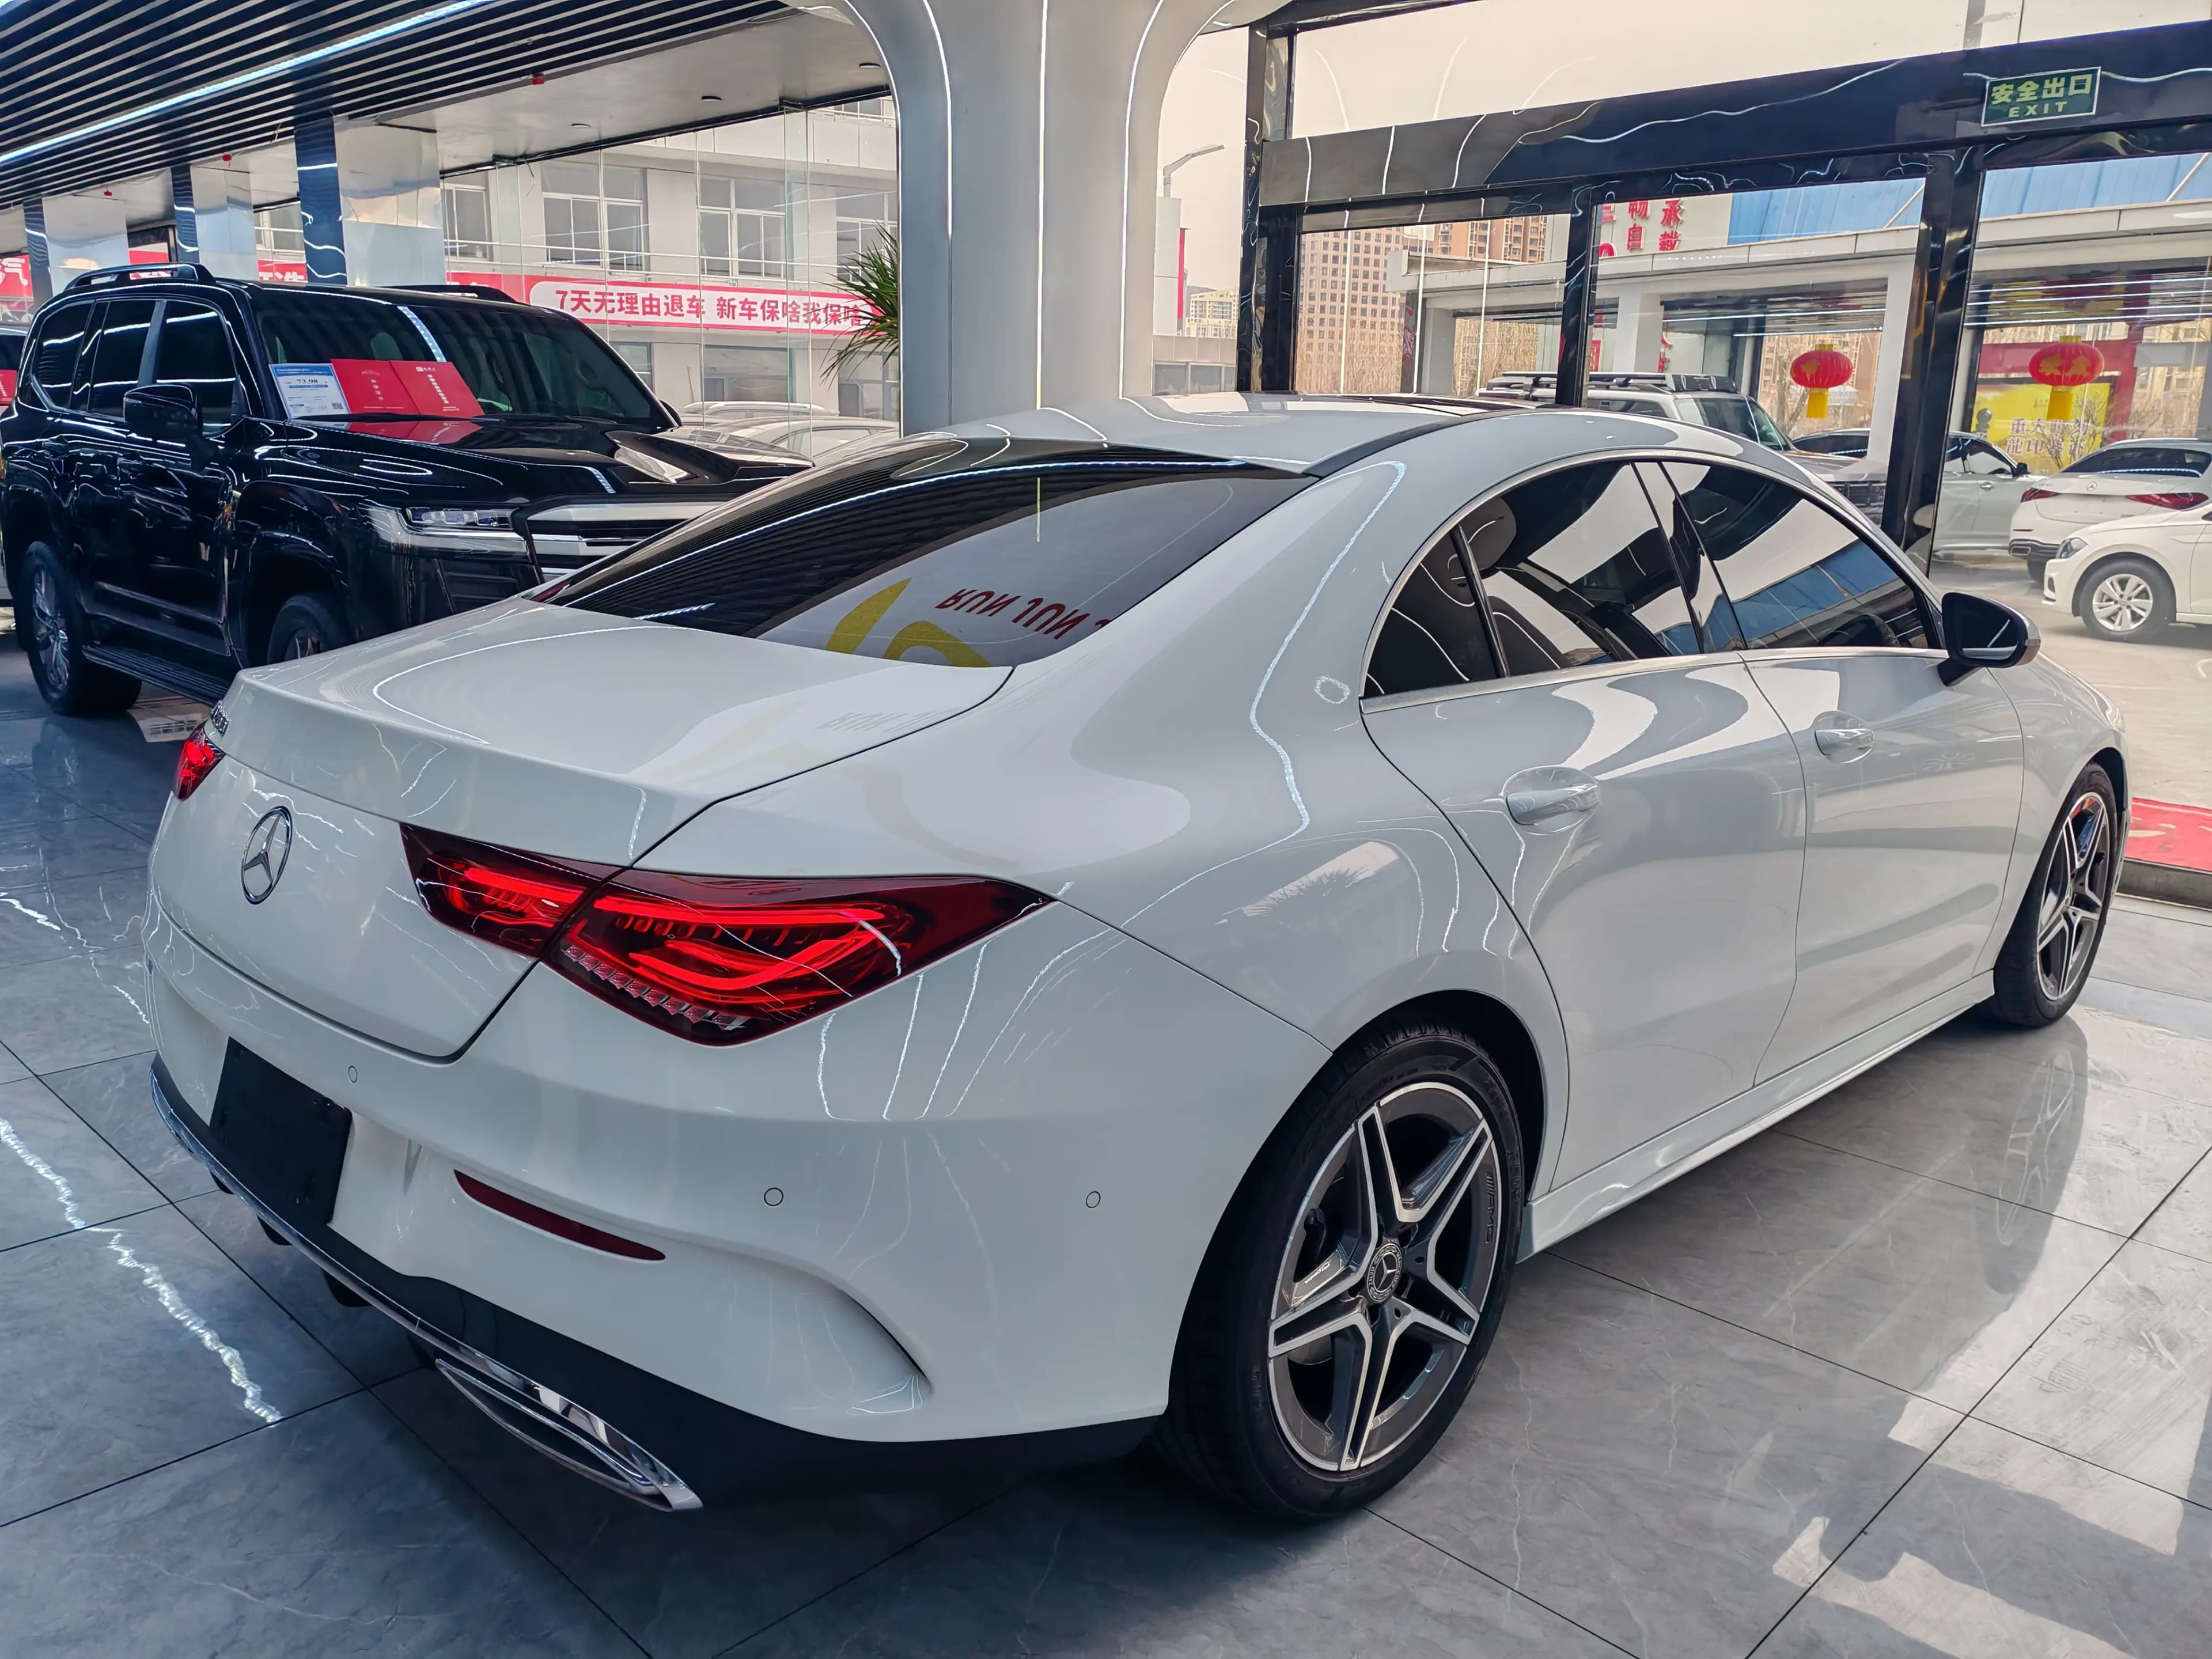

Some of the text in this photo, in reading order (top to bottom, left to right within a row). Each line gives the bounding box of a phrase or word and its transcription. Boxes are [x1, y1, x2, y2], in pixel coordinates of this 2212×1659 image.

[1991, 74, 2093, 105] 安全出口
[2009, 101, 2067, 118] EXIT
[555, 290, 705, 319] 7天无理由退车
[1484, 1192, 1496, 1244] AMG
